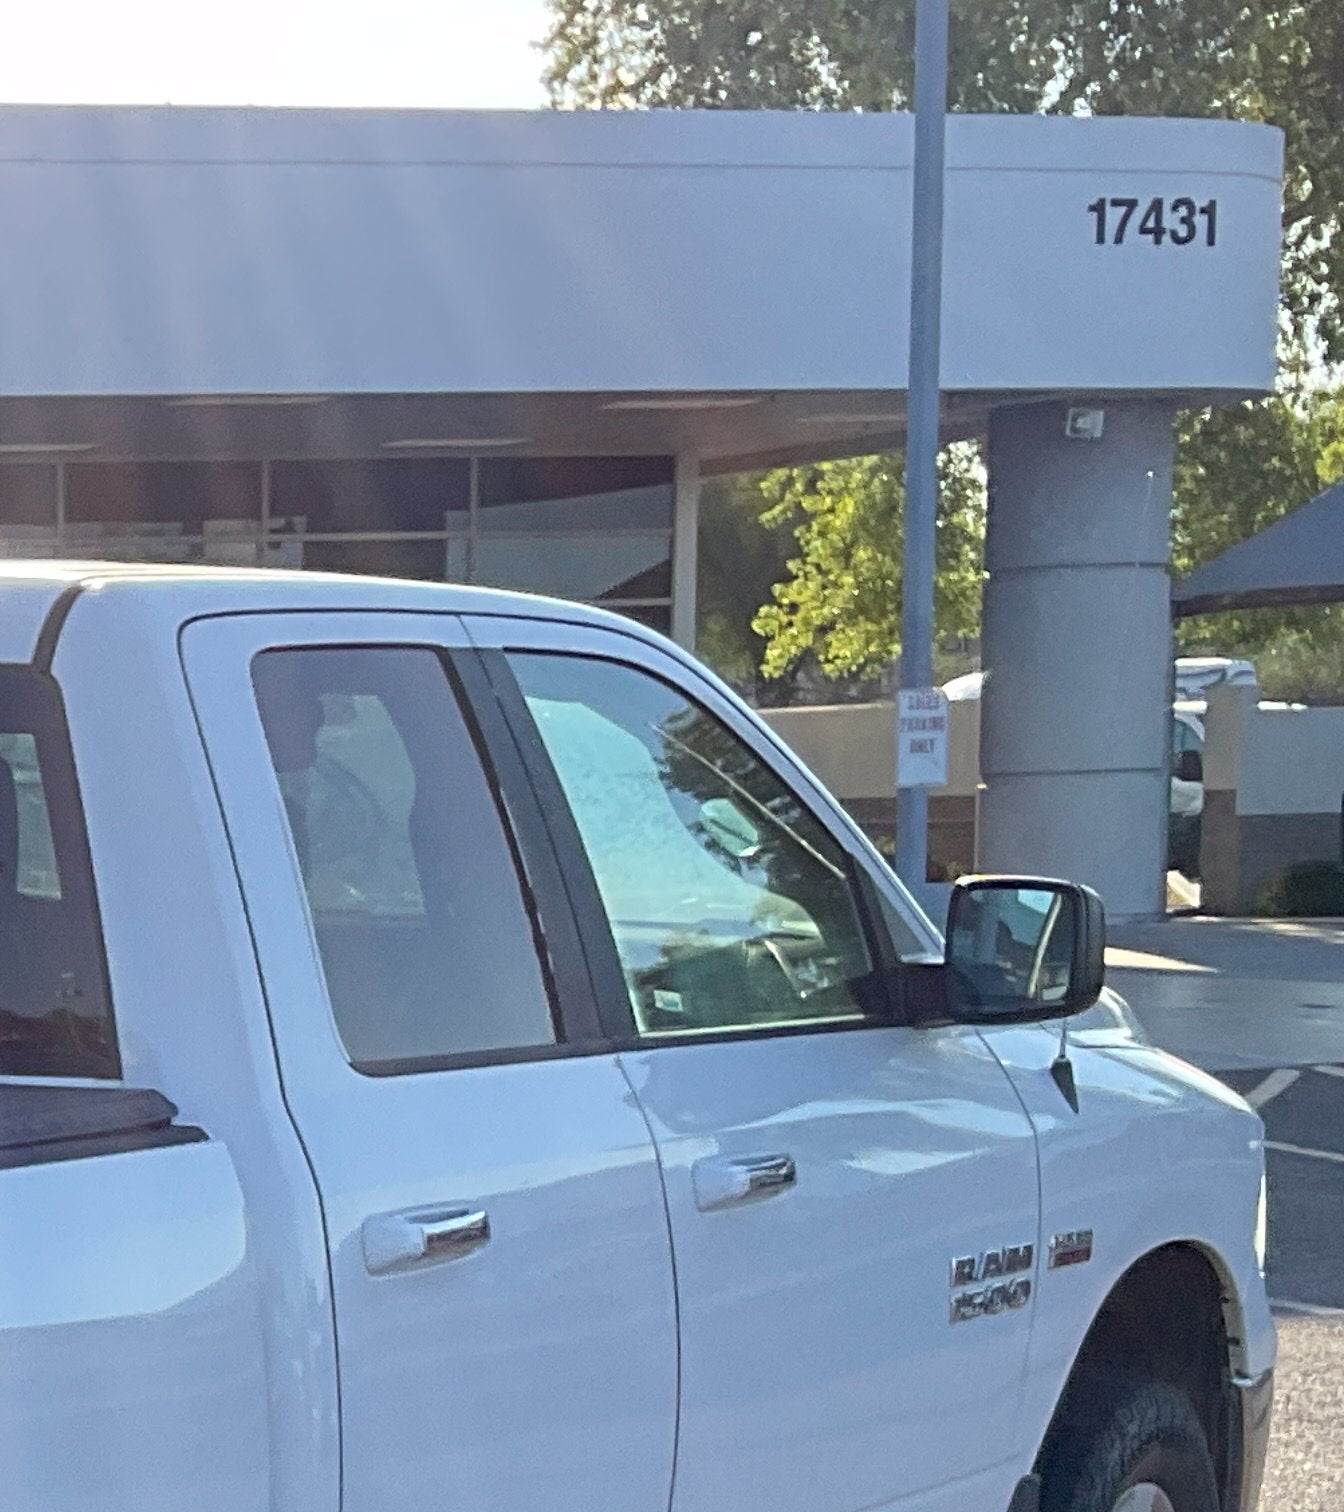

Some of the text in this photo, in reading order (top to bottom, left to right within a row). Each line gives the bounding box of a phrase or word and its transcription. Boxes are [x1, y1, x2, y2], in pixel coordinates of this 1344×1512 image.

[1087, 197, 1217, 247] 17431
[899, 717, 945, 732] PARKING
[910, 738, 936, 753] ONLY
[949, 1243, 1033, 1287] RAM
